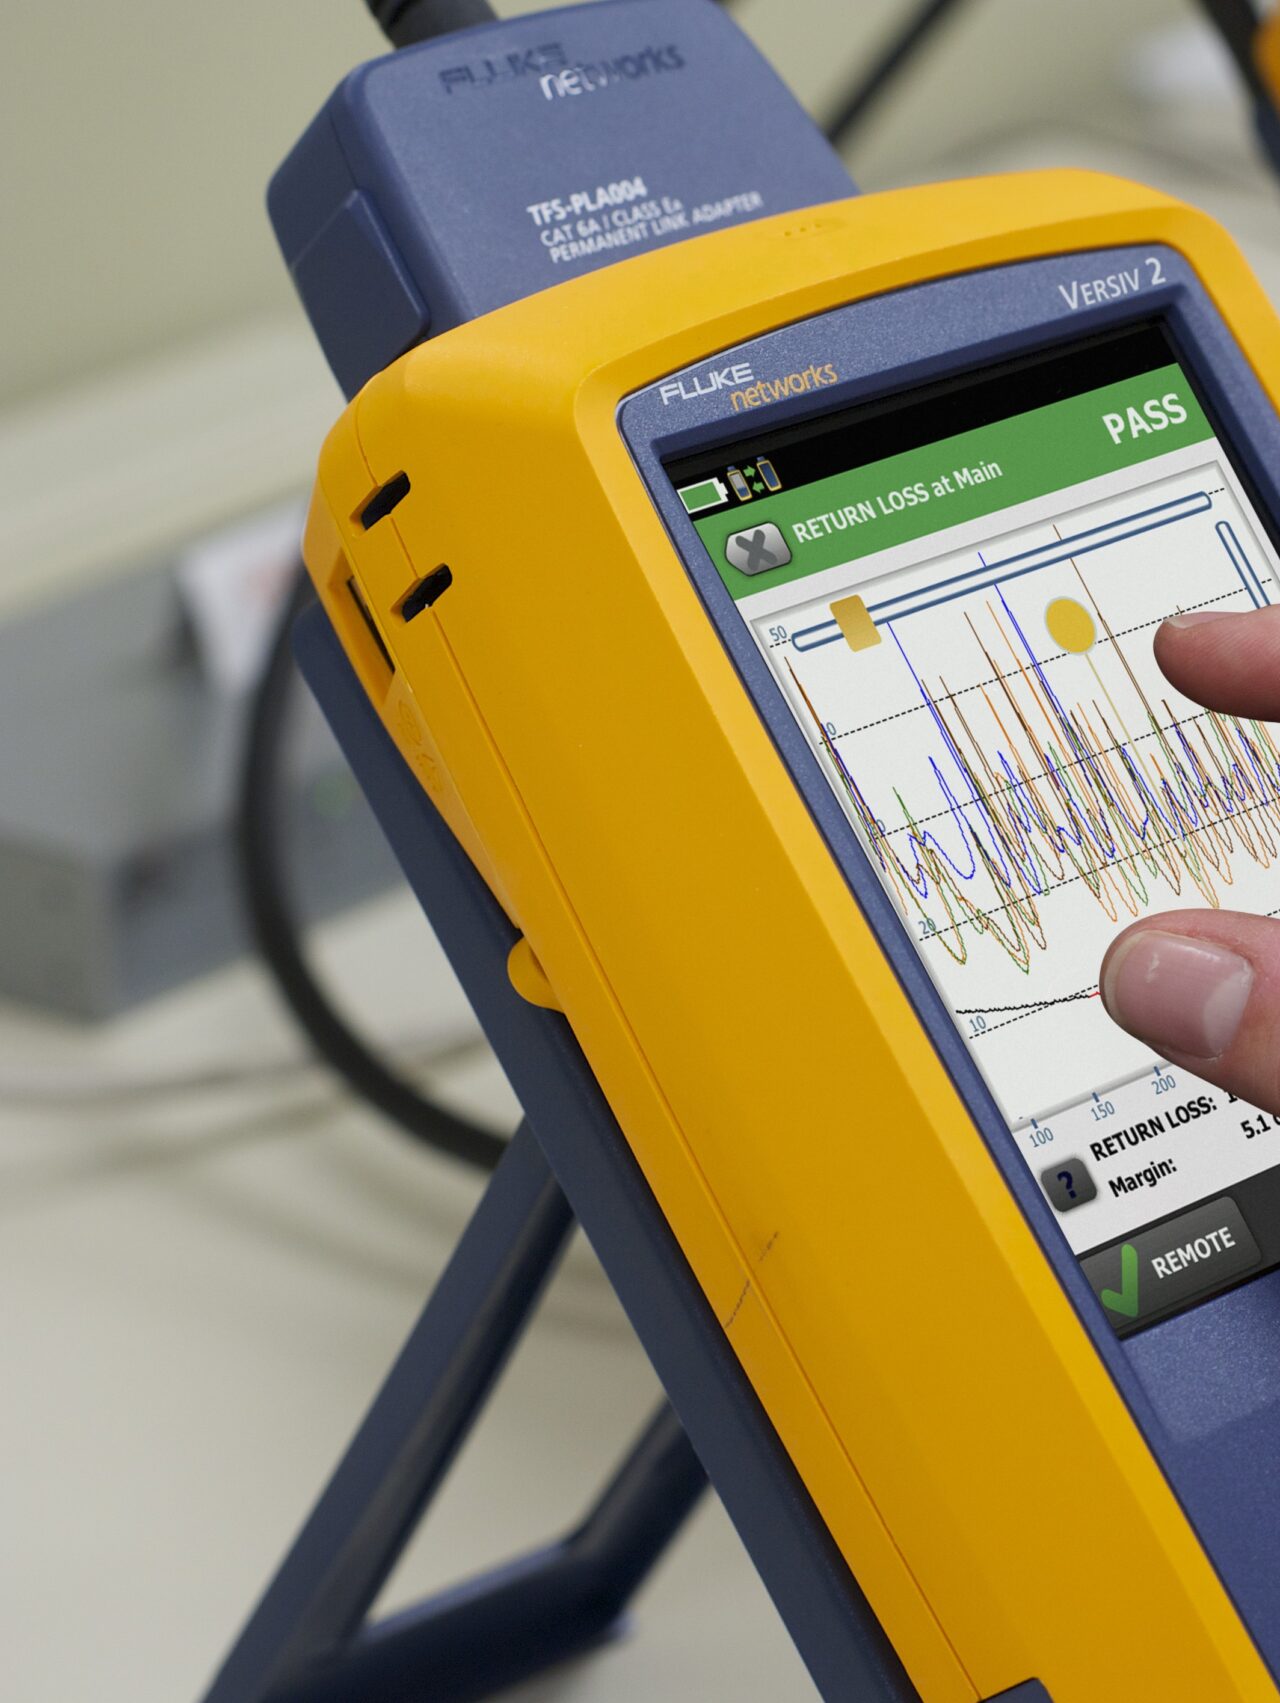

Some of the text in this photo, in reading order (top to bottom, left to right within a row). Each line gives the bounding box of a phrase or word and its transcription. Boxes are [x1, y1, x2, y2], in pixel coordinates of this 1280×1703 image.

[539, 44, 686, 101] networks
[526, 175, 648, 226] TFS-PLA004
[540, 224, 573, 247] CAT
[576, 217, 601, 238] 6A
[611, 200, 661, 228] CLASS
[549, 191, 764, 264] PERMANENT LINK ADAPTER
[1145, 256, 1167, 286] 2
[659, 362, 755, 406] FLUKE
[730, 363, 838, 412] networks
[1102, 393, 1188, 445] PASS
[792, 461, 1004, 544] RETURN LOSS at Main
[769, 624, 788, 643] 50
[969, 1014, 987, 1033] 10
[1151, 1074, 1177, 1095] 200
[1089, 1095, 1218, 1162] RETURN LOSS:
[1090, 1100, 1116, 1122] 150
[1028, 1127, 1055, 1148] 100
[1108, 1158, 1178, 1198] Margin:
[1240, 1113, 1272, 1140] 5.1
[1151, 1226, 1236, 1280] REMOTE
